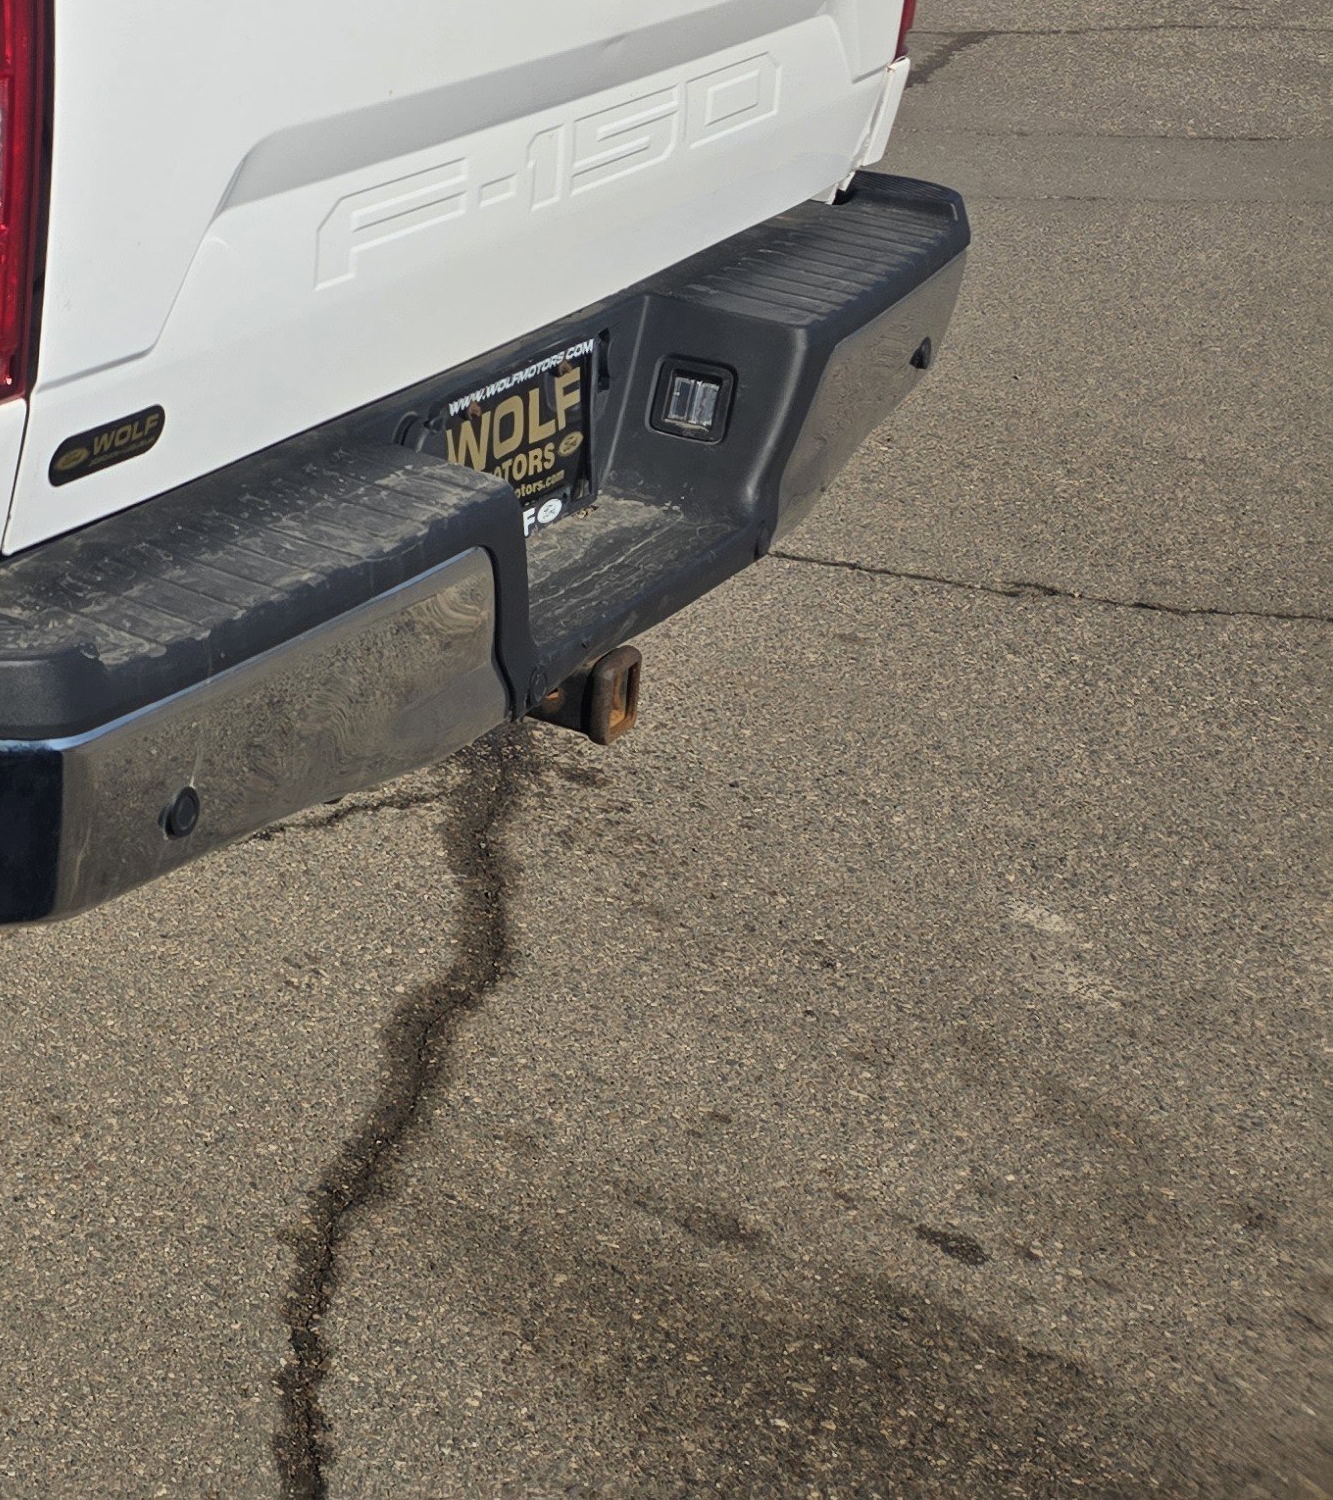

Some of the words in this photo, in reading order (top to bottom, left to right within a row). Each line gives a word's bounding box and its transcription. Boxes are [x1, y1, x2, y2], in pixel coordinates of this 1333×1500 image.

[314, 51, 782, 291] F-150
[449, 338, 594, 417] WWW.WOLFMOTORSCOM
[93, 413, 160, 455] WOLF
[446, 366, 581, 473] WOLF
[493, 442, 555, 481] OTORS
